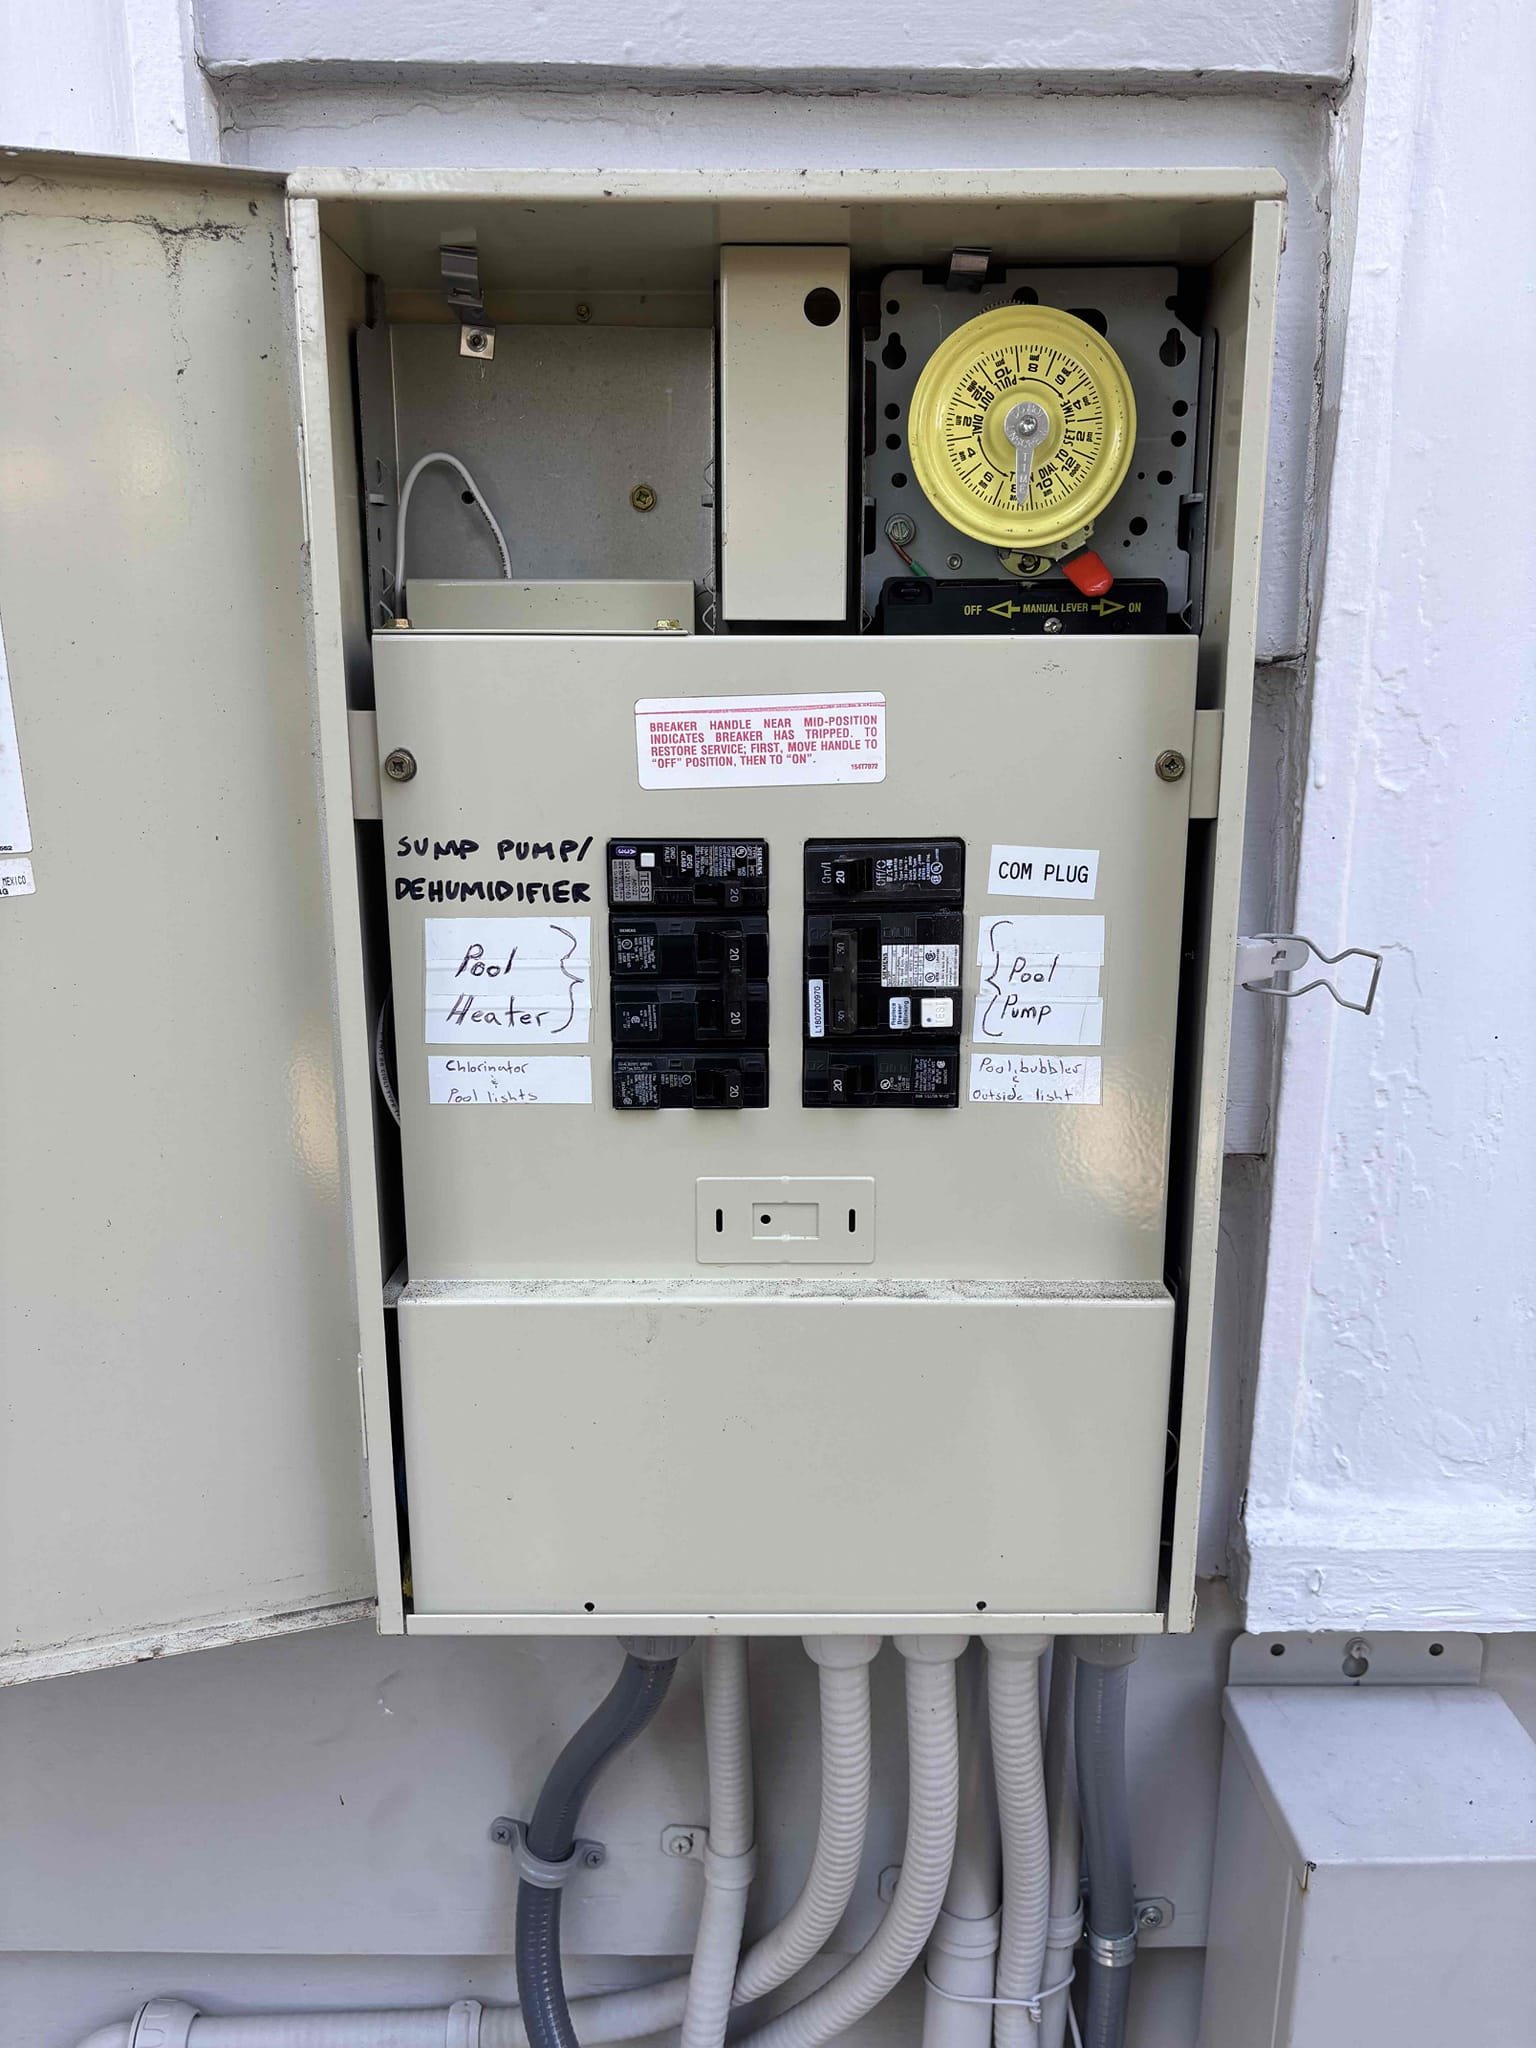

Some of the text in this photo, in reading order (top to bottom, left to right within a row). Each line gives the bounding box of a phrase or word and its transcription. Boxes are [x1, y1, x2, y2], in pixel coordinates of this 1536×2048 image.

[994, 366, 1012, 379] 10
[1027, 362, 1039, 373] 8
[1054, 374, 1066, 385] 6
[971, 385, 987, 401] 12
[972, 374, 1017, 436] PULL OUT DIAL
[1060, 399, 1076, 424] TIME
[1072, 399, 1082, 410] 4
[962, 415, 972, 427] 2
[1062, 428, 1076, 447] SET
[1076, 430, 1085, 442] 2
[967, 447, 976, 458] 4
[1055, 448, 1069, 462] TO
[1038, 462, 1059, 480] DIAL
[1061, 456, 1077, 472] 12
[983, 471, 994, 483] 6
[1035, 478, 1053, 491] 10
[963, 602, 1142, 616] OFF MANUAL LEVER ON
[649, 714, 878, 732] BREAKER HANDLE NEAR MID-POSITION
[650, 726, 878, 744] INDICATES BREAKER HAS TRIPPED. TO
[651, 739, 878, 757] RESTORE SERVICE; FIRST, MOVE HANDLE TO
[651, 753, 816, 769] "OFF" POSITION, THEN TO "ON".
[396, 835, 594, 863] SUMP PUMP/
[2, 874, 27, 887] MEXICO
[835, 870, 846, 884] 20
[998, 861, 1090, 884] COM PLUG
[394, 877, 592, 904] DEHUMIDIFIER
[640, 872, 650, 900] TEST
[729, 888, 739, 903] 20
[454, 943, 518, 978] Pool
[729, 948, 740, 961] 20
[1008, 953, 1060, 983] Pool
[446, 992, 550, 1027] Heater
[1000, 993, 1052, 1026] Pump
[730, 1011, 741, 1025] 20
[445, 1059, 529, 1074] Chlorinator
[1019, 1057, 1083, 1075] bubbler
[729, 1084, 740, 1098] 20
[833, 1079, 843, 1092] 20
[447, 1087, 478, 1103] Pool
